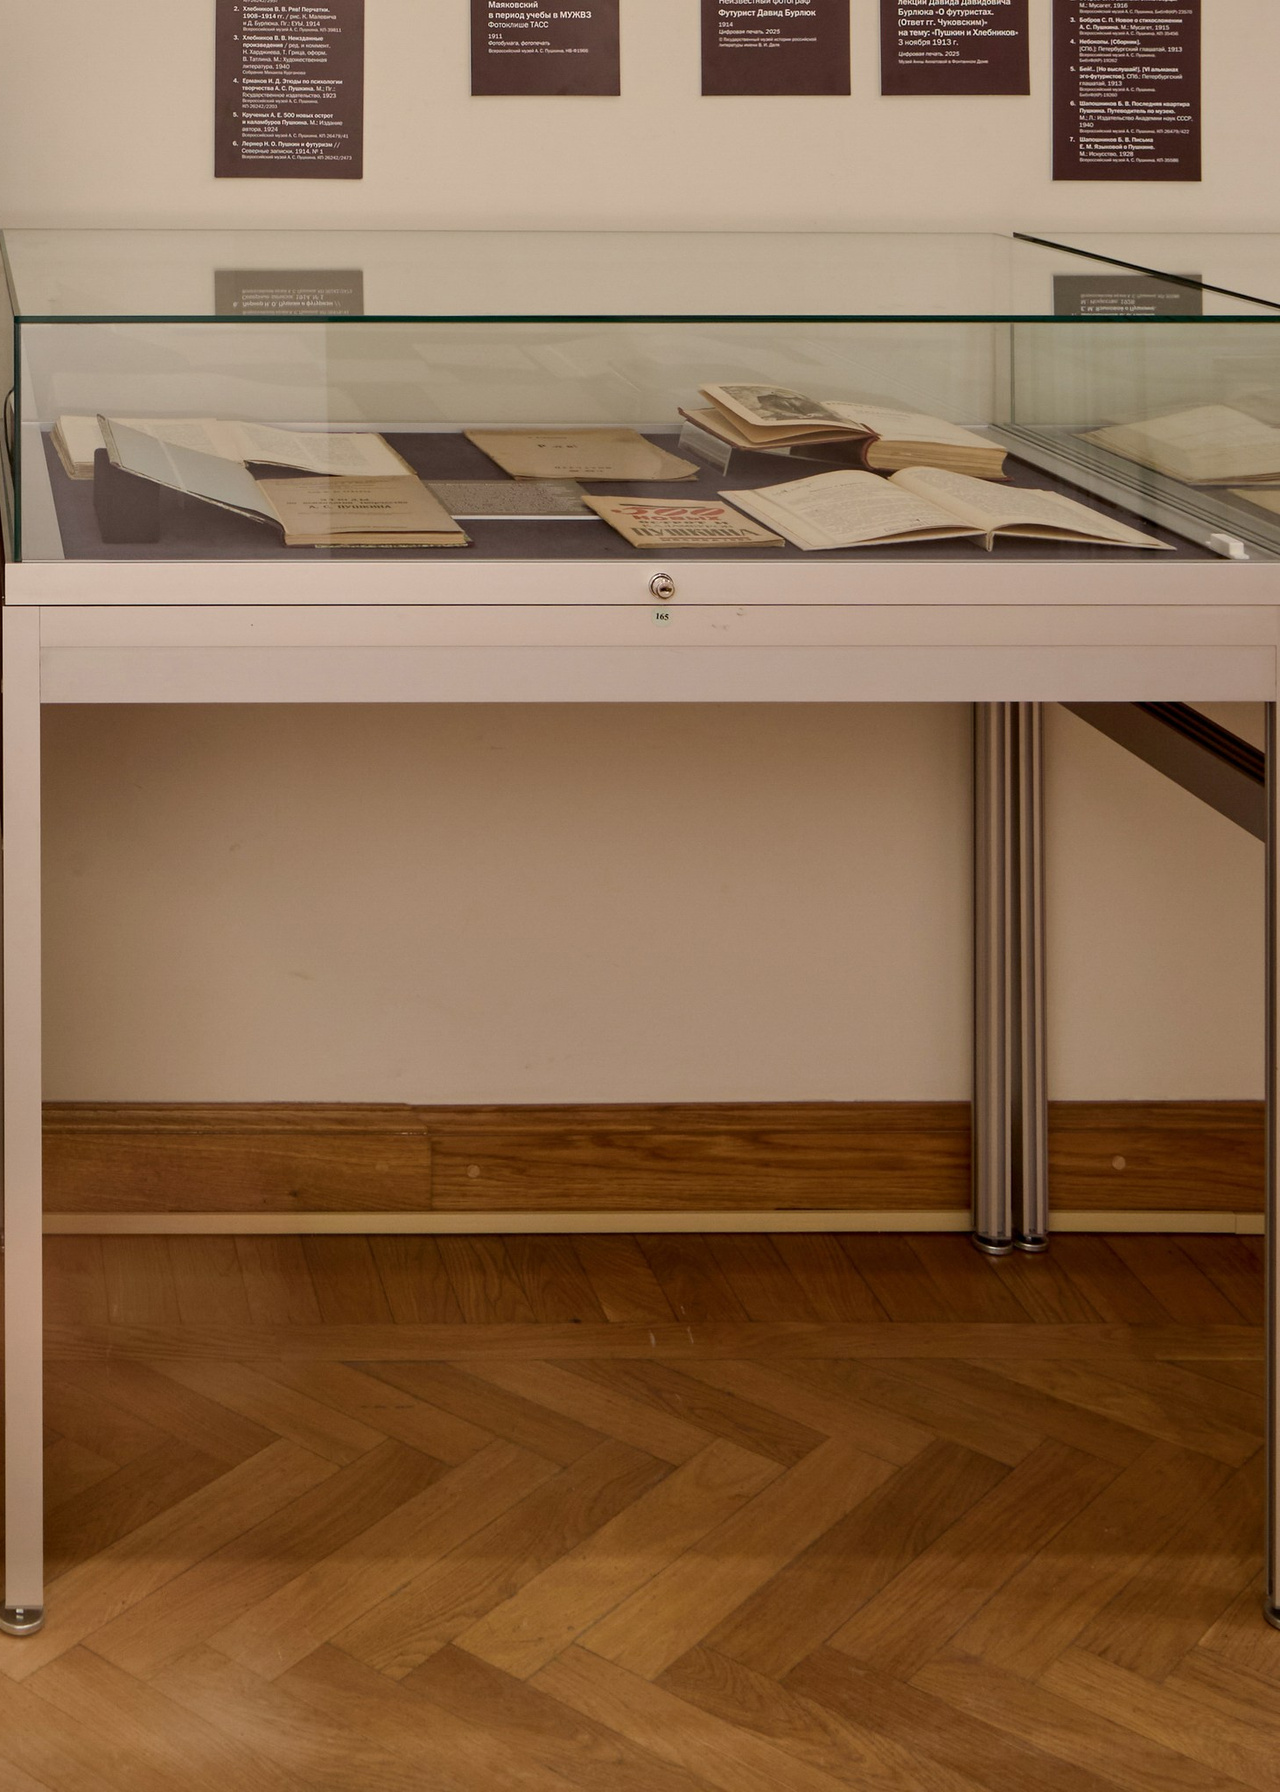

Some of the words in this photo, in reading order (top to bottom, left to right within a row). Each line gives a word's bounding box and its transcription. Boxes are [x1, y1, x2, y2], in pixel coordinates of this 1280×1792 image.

[488, 0, 539, 9] Маяковский
[495, 12, 525, 20] период
[525, 11, 552, 21] учебы
[559, 10, 592, 19] МУЖВЗ
[717, 9, 756, 19] Футурист
[756, 8, 784, 18] Давид
[784, 8, 817, 18] Бурлюк
[487, 21, 529, 29] Фотоклише
[529, 20, 549, 29] ТАСС
[630, 527, 759, 537] ПУШКИНА
[656, 612, 669, 621] 165
